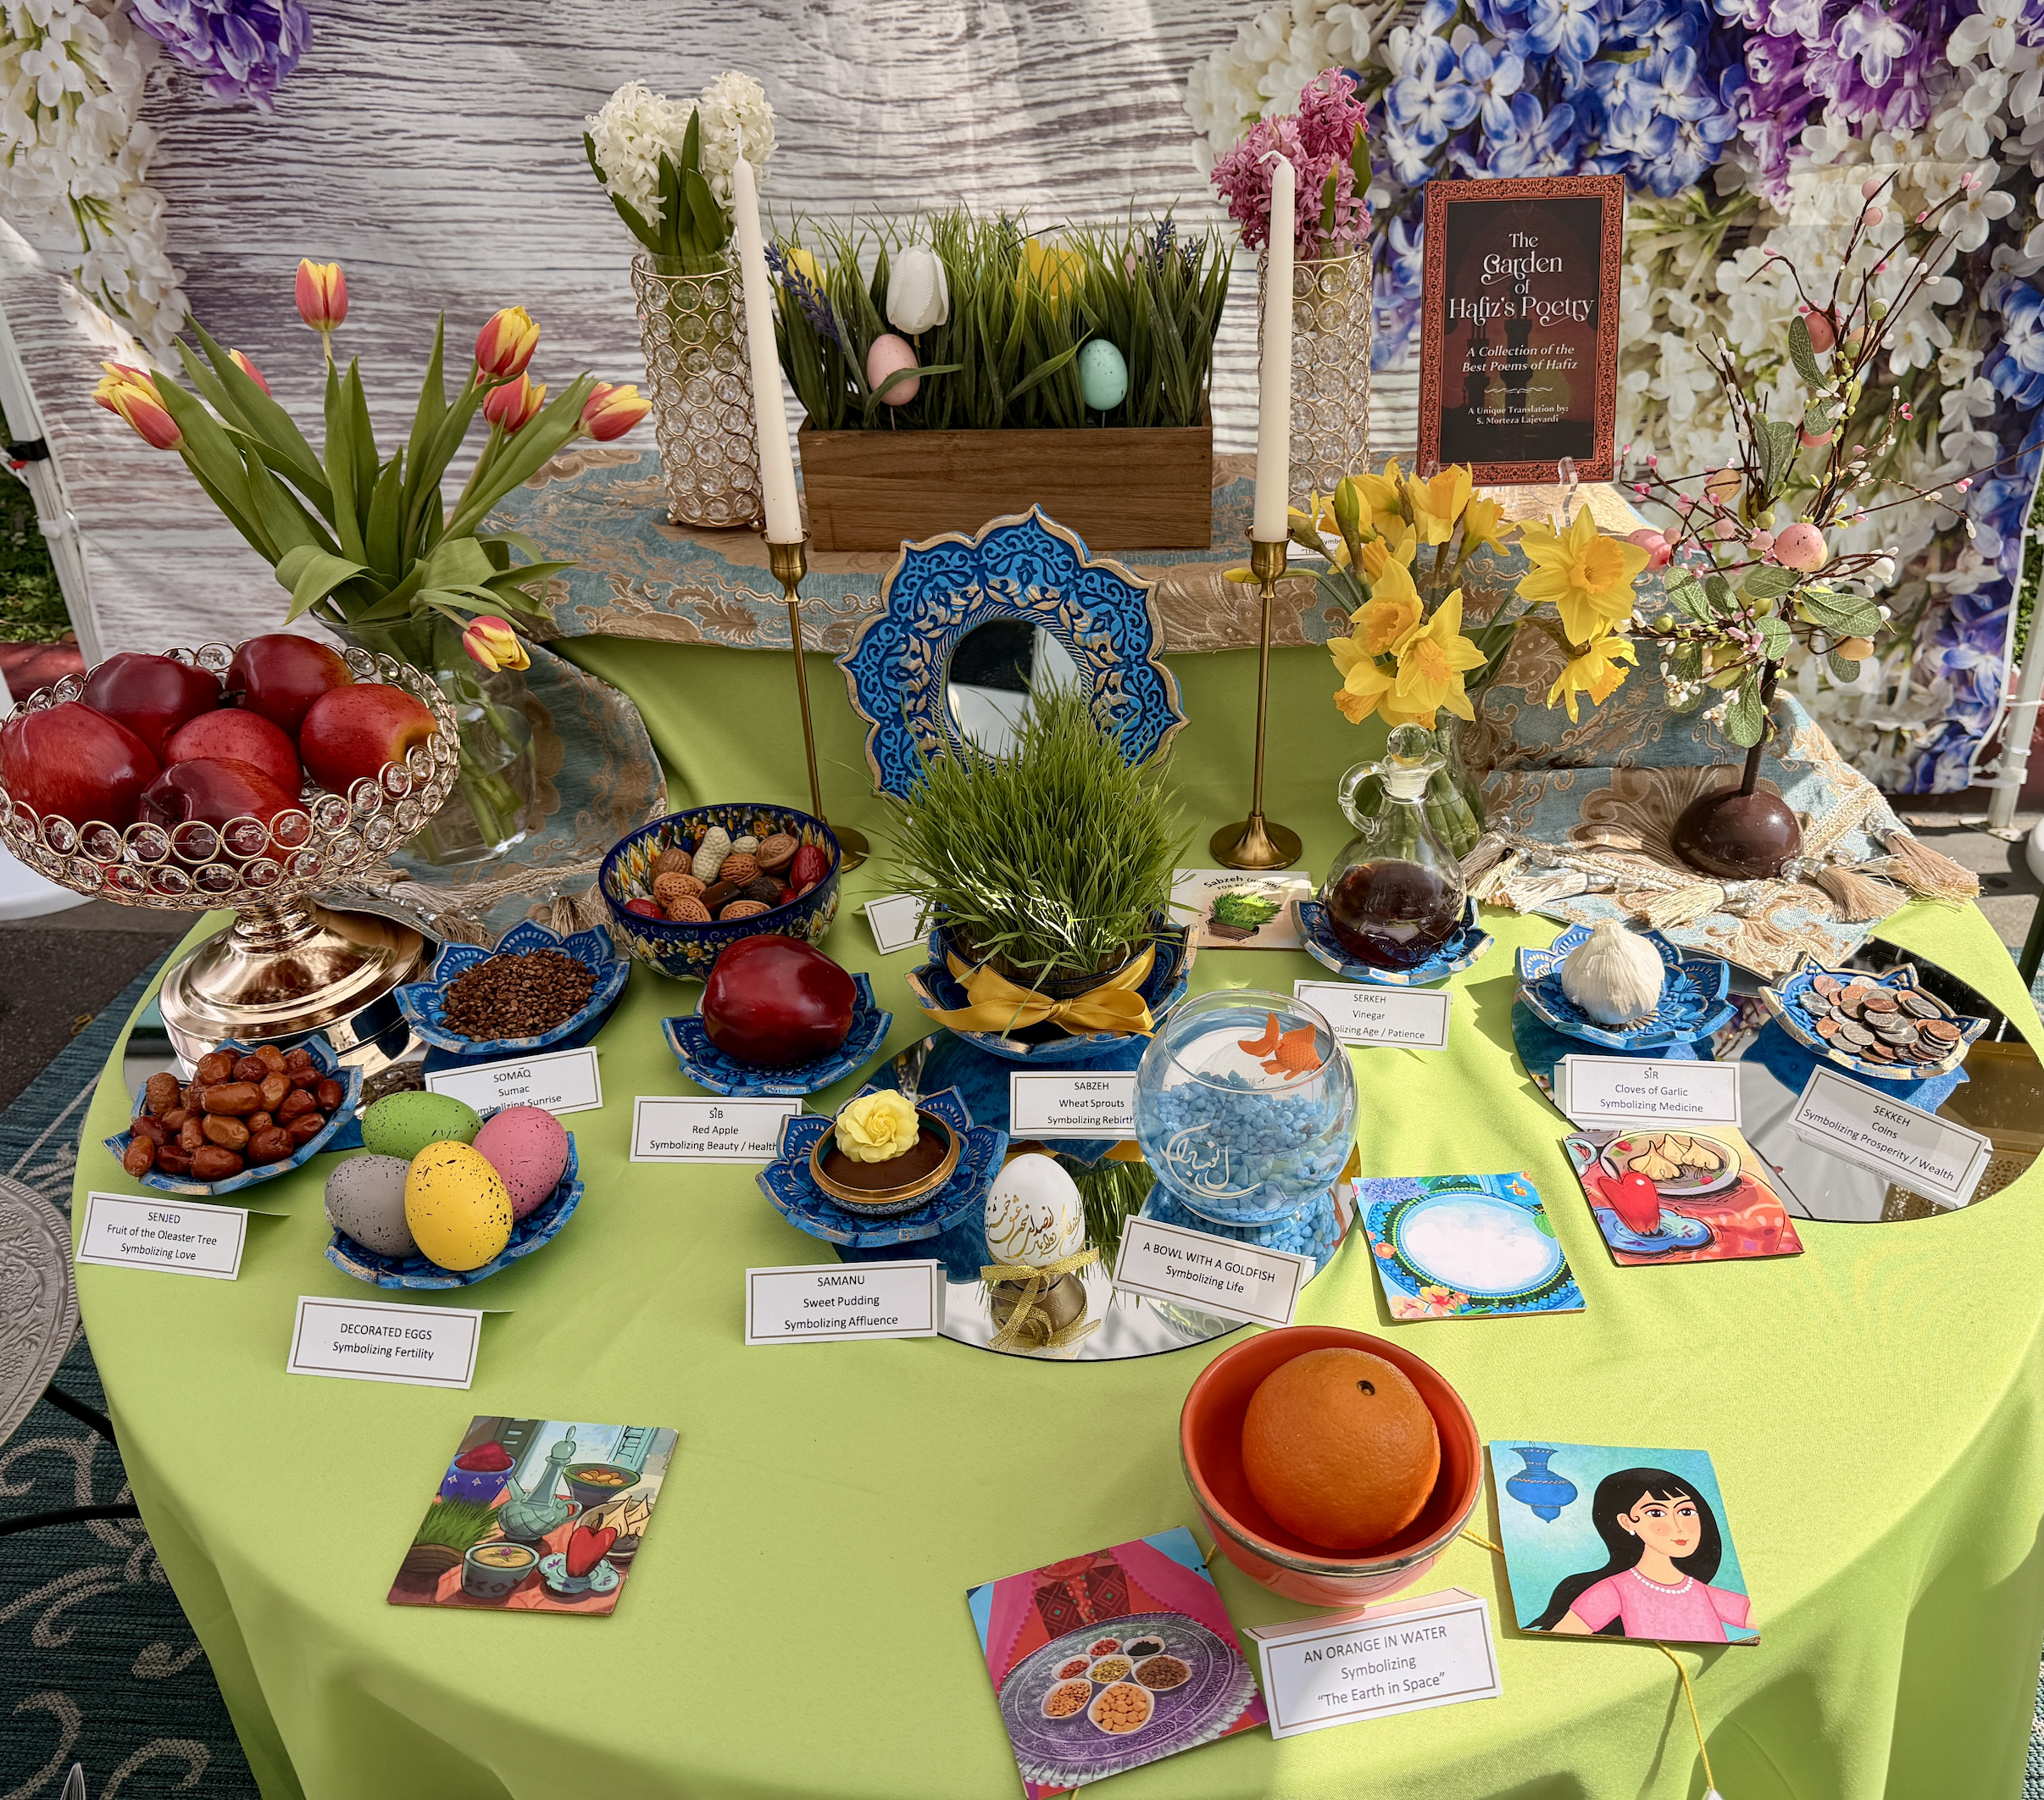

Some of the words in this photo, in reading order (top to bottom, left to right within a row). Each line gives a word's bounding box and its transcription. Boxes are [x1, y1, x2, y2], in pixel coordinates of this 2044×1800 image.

[1508, 231, 1539, 248] The
[1480, 253, 1562, 286] Garden
[1514, 279, 1530, 295] of
[1521, 297, 1595, 326] Poetry
[1466, 346, 1475, 357] A
[1479, 346, 1537, 357] Collection
[1540, 345, 1553, 356] of
[1555, 345, 1575, 355] the
[1462, 362, 1486, 373] Best
[1490, 361, 1528, 372] Poems
[1530, 360, 1544, 371] of
[1546, 359, 1578, 370] Hafiz
[1475, 406, 1506, 416] Unique
[1507, 405, 1554, 414] Translation
[1556, 404, 1569, 414] by:
[1521, 414, 1559, 425] Lajevardi
[1203, 875, 1243, 887] Sabzeh
[1353, 994, 1386, 1003] SERKEH
[1352, 1010, 1386, 1020] Vinegar
[1330, 1025, 1361, 1036] olizing
[1363, 1027, 1379, 1036] Age
[1380, 1028, 1386, 1036] /
[1388, 1029, 1425, 1039] Patience
[498, 1086, 530, 1097] Sumac
[1075, 1082, 1109, 1091] SABZEH
[1615, 1084, 1646, 1094] Cloves
[1648, 1086, 1658, 1095] of
[1660, 1086, 1688, 1097] Garlic
[474, 1101, 525, 1116] ymbolizing
[527, 1095, 562, 1108] Sunrise
[1059, 1099, 1088, 1108] Wheat
[1091, 1099, 1125, 1109] Sprouts
[1600, 1099, 1657, 1111] Symbolizing
[1659, 1102, 1703, 1112] Medicine
[1047, 1115, 1101, 1125] Symbolizing
[1873, 1105, 1911, 1127] SEKKEH
[692, 1125, 709, 1134] Red
[713, 1125, 739, 1136] Apple
[1871, 1122, 1898, 1139] Coins
[650, 1141, 704, 1152] Symbolizing
[708, 1142, 739, 1153] Beauty
[741, 1142, 746, 1151] /
[1803, 1108, 1859, 1141] Symbolizing
[1861, 1134, 1910, 1164] Prosperity
[1909, 1156, 1918, 1164] /
[1919, 1158, 1954, 1181] Wealth
[147, 1212, 181, 1224] SENJED
[107, 1225, 127, 1236] Fruit
[129, 1226, 139, 1236] of
[141, 1228, 156, 1238] the
[158, 1231, 196, 1242] Oleaster
[197, 1235, 217, 1245] Tree
[120, 1243, 173, 1259] Symbolizing
[175, 1249, 196, 1260] Love
[1143, 1242, 1150, 1252] A
[1153, 1244, 1183, 1259] BOWL
[1186, 1252, 1213, 1267] WITH
[1214, 1259, 1222, 1269] A
[1225, 1262, 1275, 1283] GOLDFISH
[818, 1275, 865, 1286] SAMANU
[1165, 1265, 1224, 1290] Symbolizing
[1226, 1281, 1244, 1293] Life
[803, 1297, 835, 1308] Sweet
[837, 1296, 880, 1307] Pudding
[785, 1318, 847, 1331] Symbolizing
[848, 1316, 898, 1327] Affluence
[341, 1323, 402, 1337] DECORATED
[405, 1329, 432, 1340] EGGS
[333, 1342, 392, 1358] Symbolizing
[395, 1347, 434, 1361] Fertility
[1303, 1649, 1322, 1664] AN
[1325, 1638, 1381, 1659] ORANGE
[1384, 1635, 1397, 1648] IN
[1400, 1625, 1447, 1645] WATER
[1341, 1657, 1417, 1681] Symbolizing
[1318, 1692, 1348, 1707] “The
[1351, 1684, 1385, 1702] Earth
[1388, 1682, 1399, 1693] in
[1402, 1672, 1445, 1693] Space”
